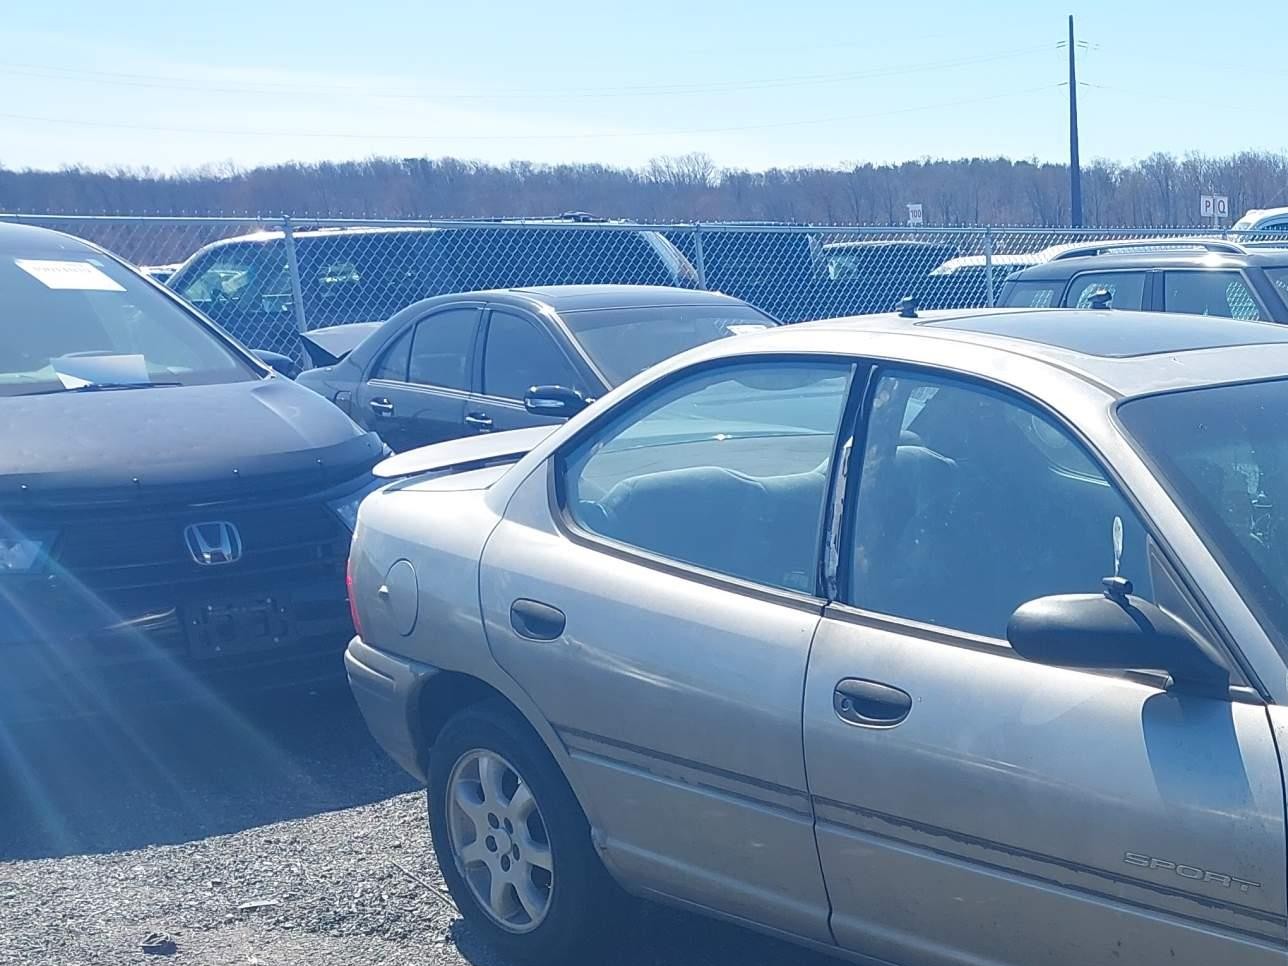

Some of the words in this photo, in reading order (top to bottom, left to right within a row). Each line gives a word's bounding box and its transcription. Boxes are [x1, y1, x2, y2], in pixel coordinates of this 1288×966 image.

[1205, 199, 1211, 213] P
[1217, 199, 1226, 214] Q
[910, 209, 922, 218] 100
[1123, 851, 1261, 892] SPORT
